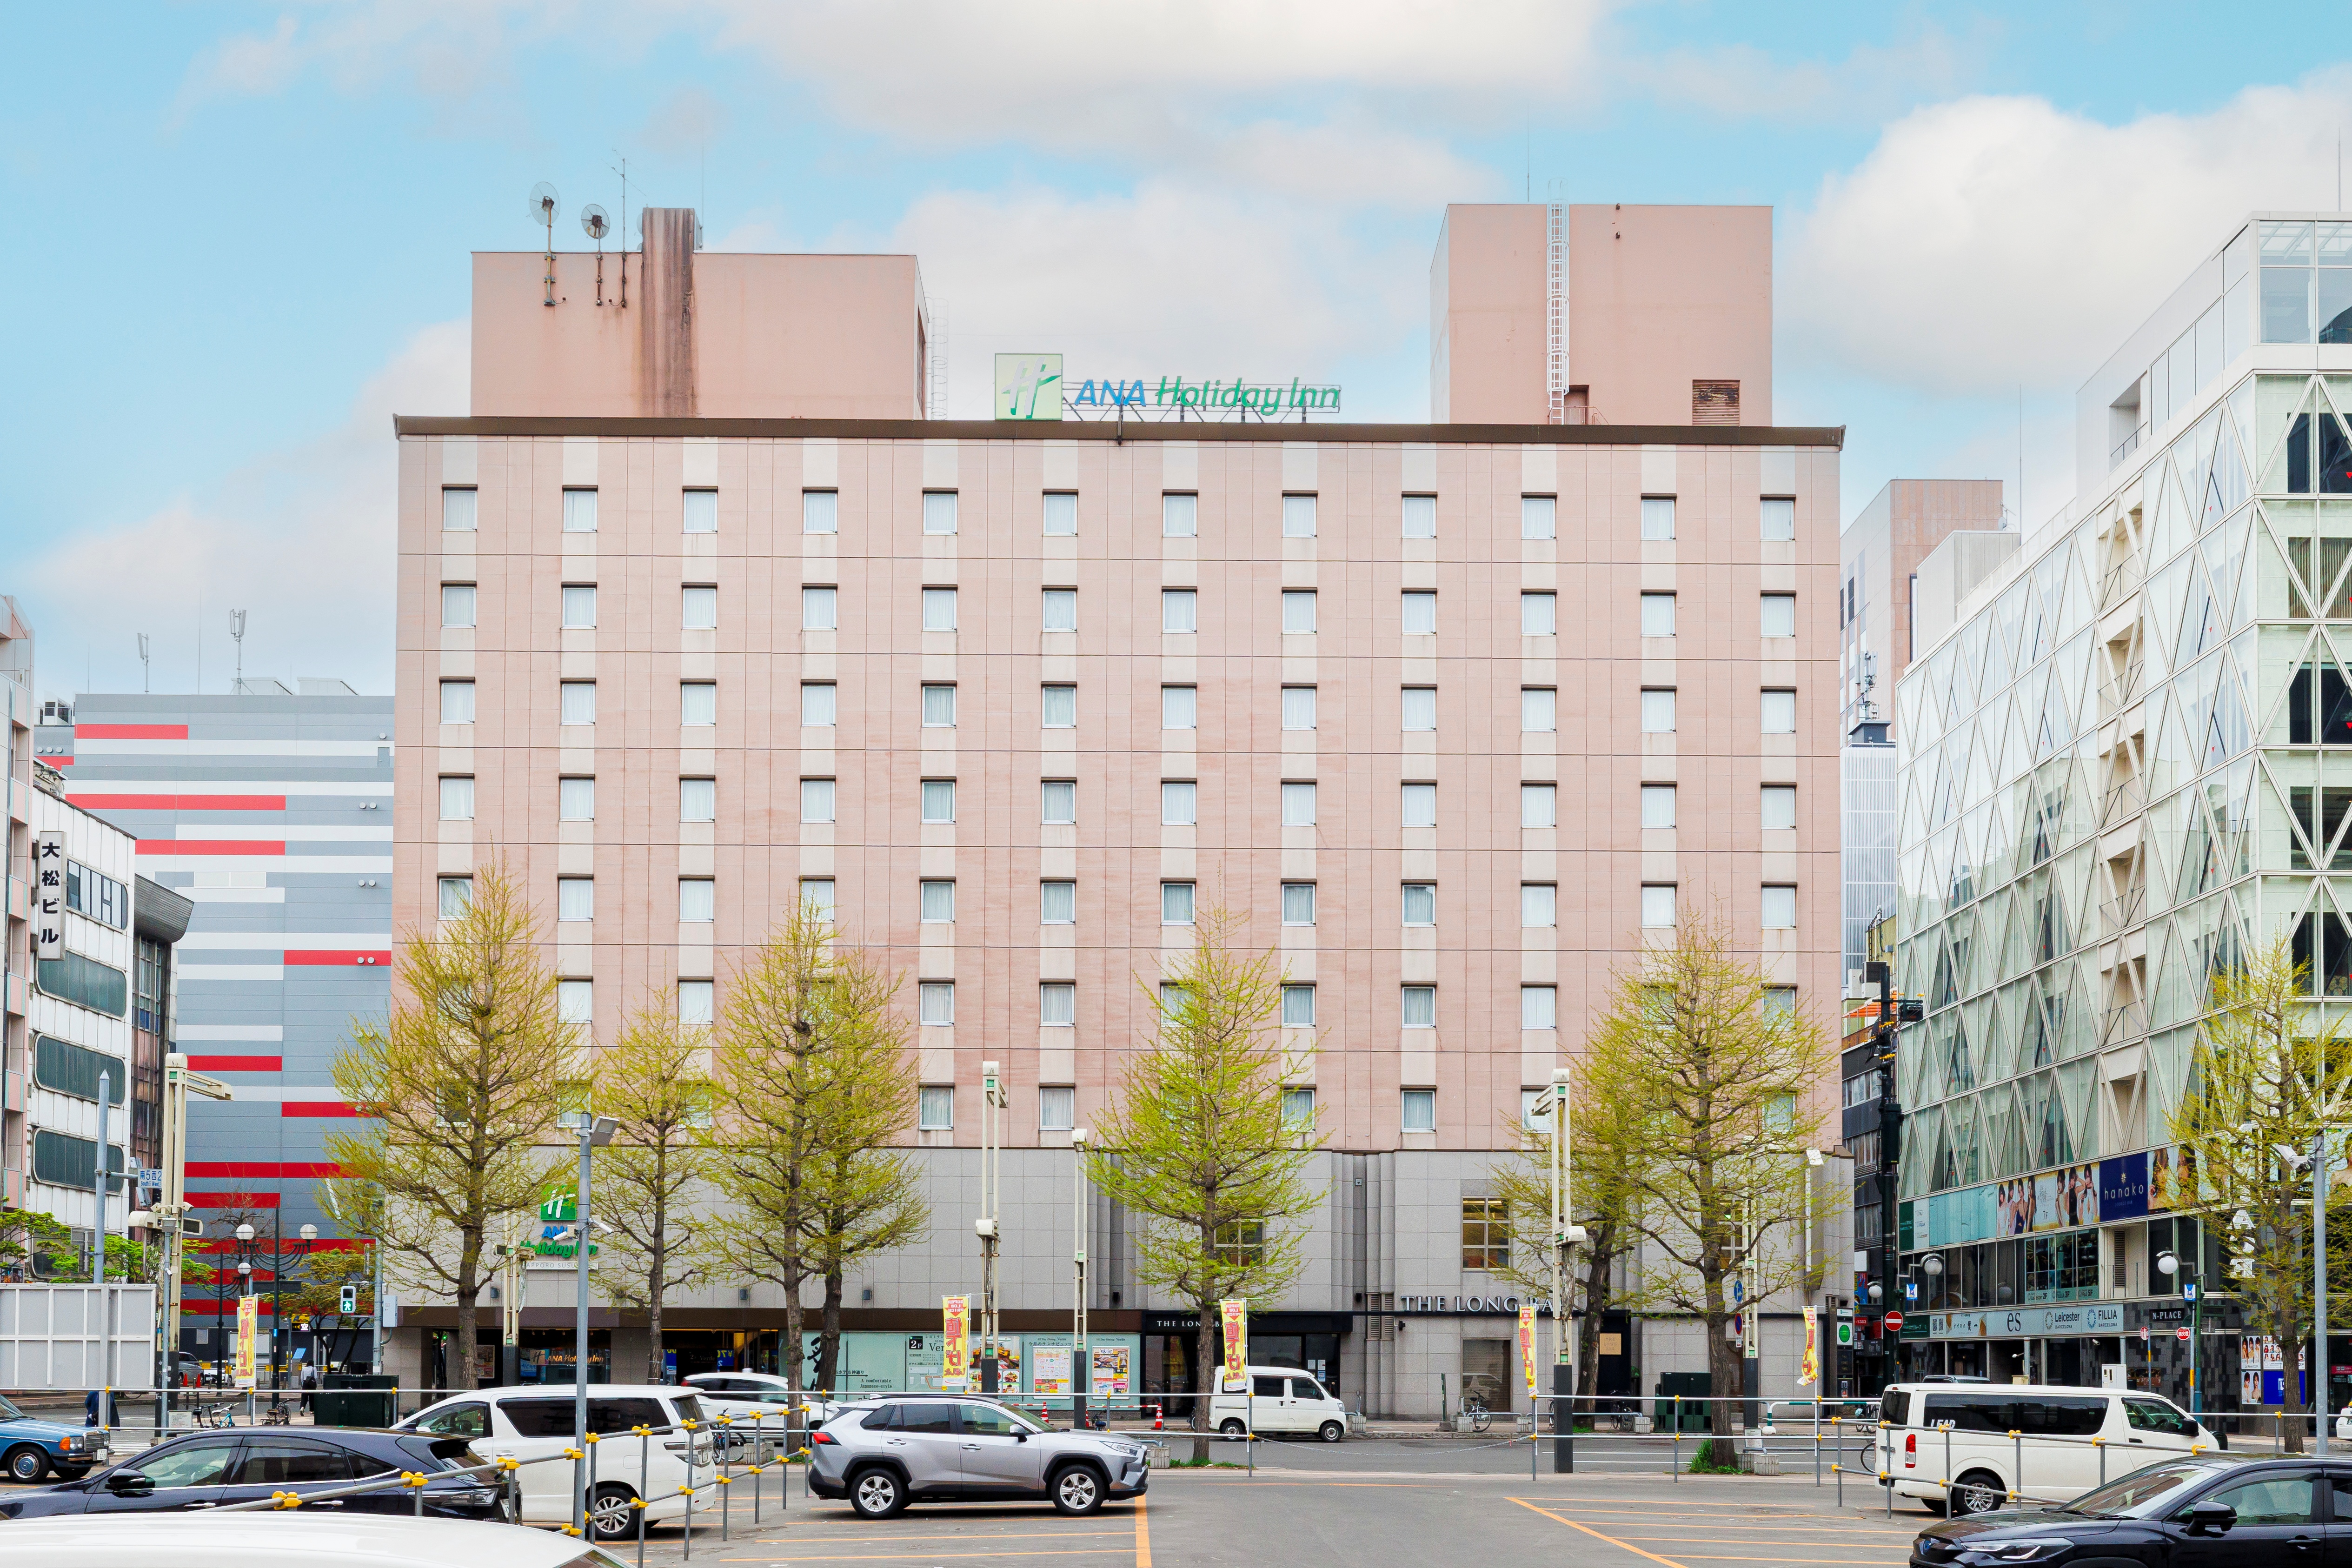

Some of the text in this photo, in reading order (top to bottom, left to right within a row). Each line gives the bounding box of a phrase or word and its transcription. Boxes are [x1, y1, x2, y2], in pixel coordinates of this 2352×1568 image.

[1075, 375, 1340, 416] ANA Holiday Inn
[40, 842, 60, 944] 大松ビル
[2105, 1183, 2144, 1200] hanako
[1401, 1296, 1446, 1312] THE
[1455, 1296, 1519, 1312] LONG
[2055, 1312, 2080, 1322] Leicester
[2098, 1309, 2117, 1320] FILLIA
[2153, 1311, 2181, 1320] N-PLACE
[2007, 1312, 2021, 1332] es
[911, 1340, 922, 1349] 2F
[929, 1343, 944, 1351] Ver
